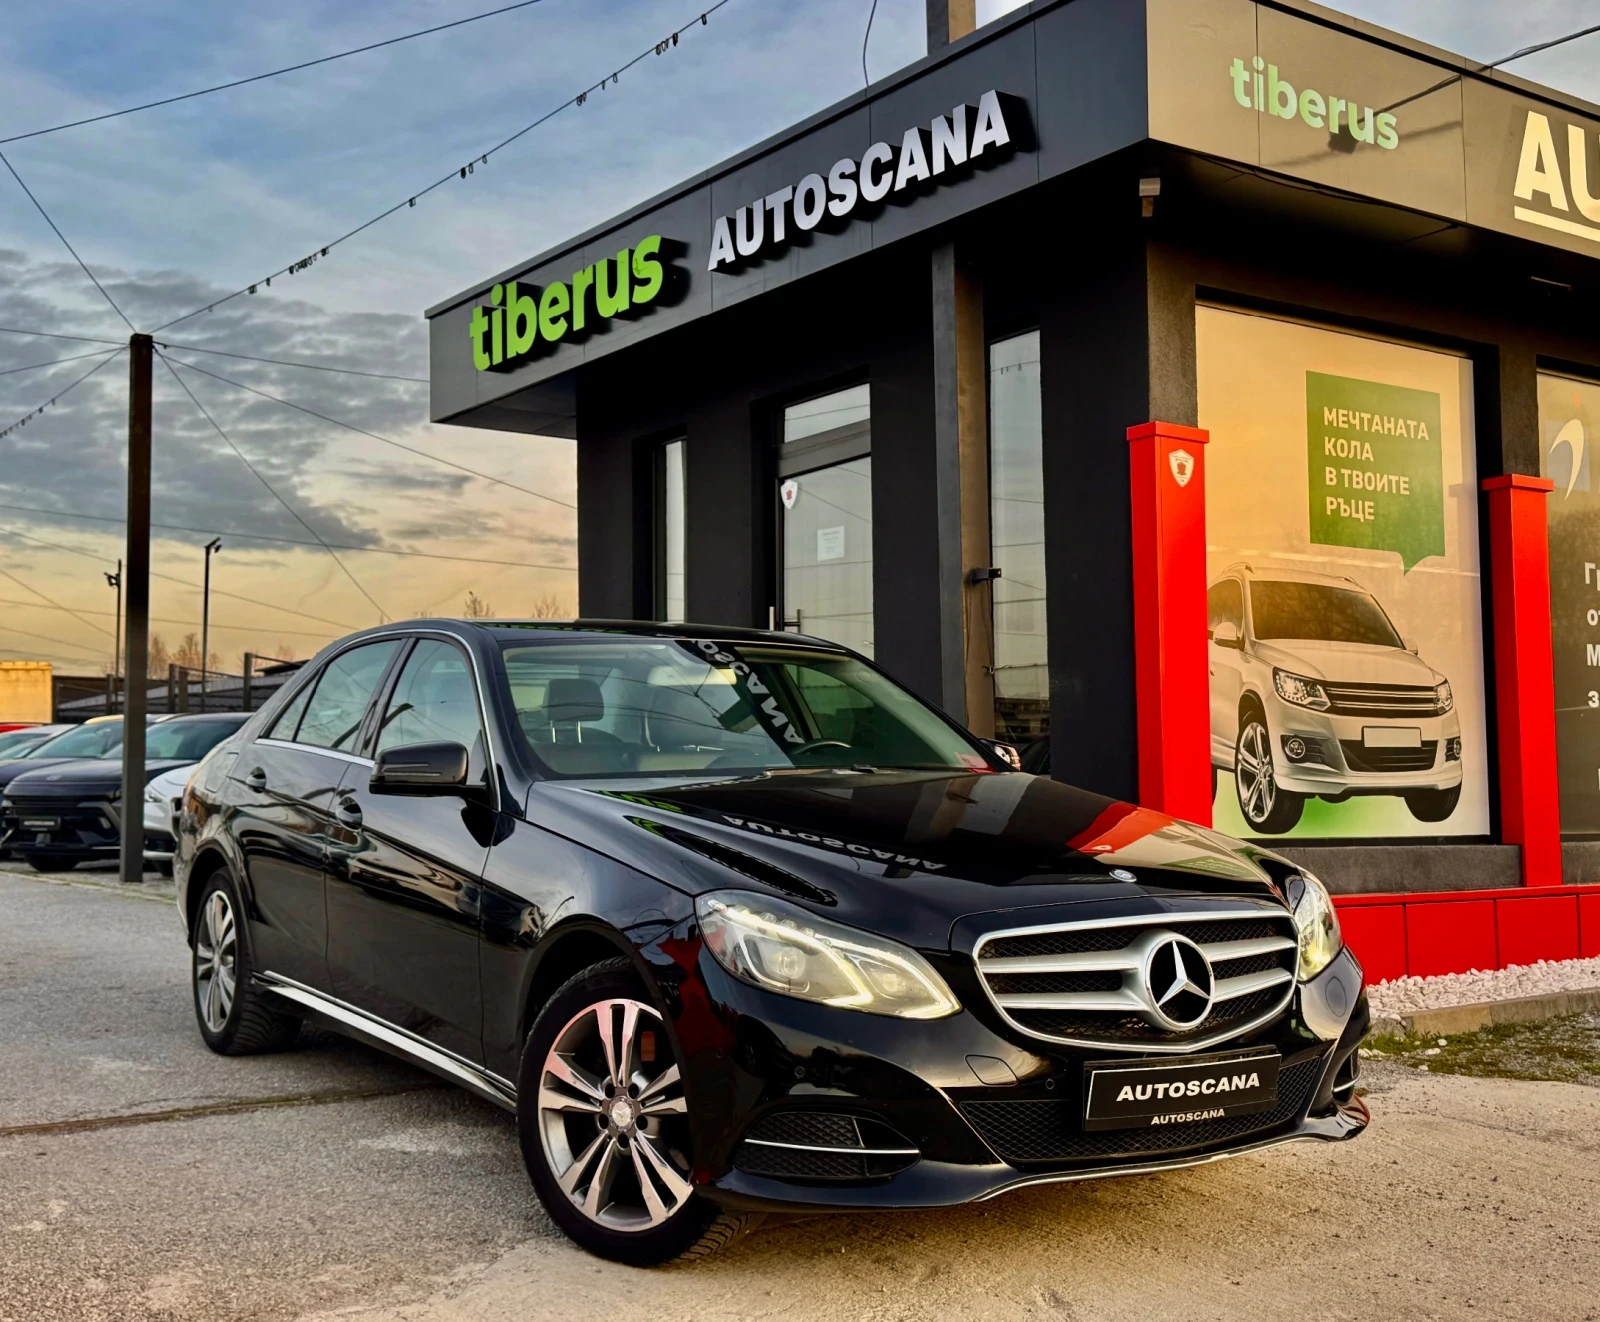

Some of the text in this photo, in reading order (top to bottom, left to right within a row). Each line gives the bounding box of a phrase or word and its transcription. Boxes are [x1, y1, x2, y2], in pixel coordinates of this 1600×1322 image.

[1230, 56, 1399, 150] tiberus
[469, 89, 1010, 371] tiberus AUTOSCANA
[1323, 406, 1429, 440] МЕЧТАНАТА
[1324, 436, 1374, 461] КОЛА
[1325, 466, 1410, 495] В ТВОИТЕ
[1326, 496, 1375, 522] РЪЦЕ
[1116, 1072, 1260, 1102] AUTOSCANA
[1150, 1108, 1225, 1126] AUTOSCANA
